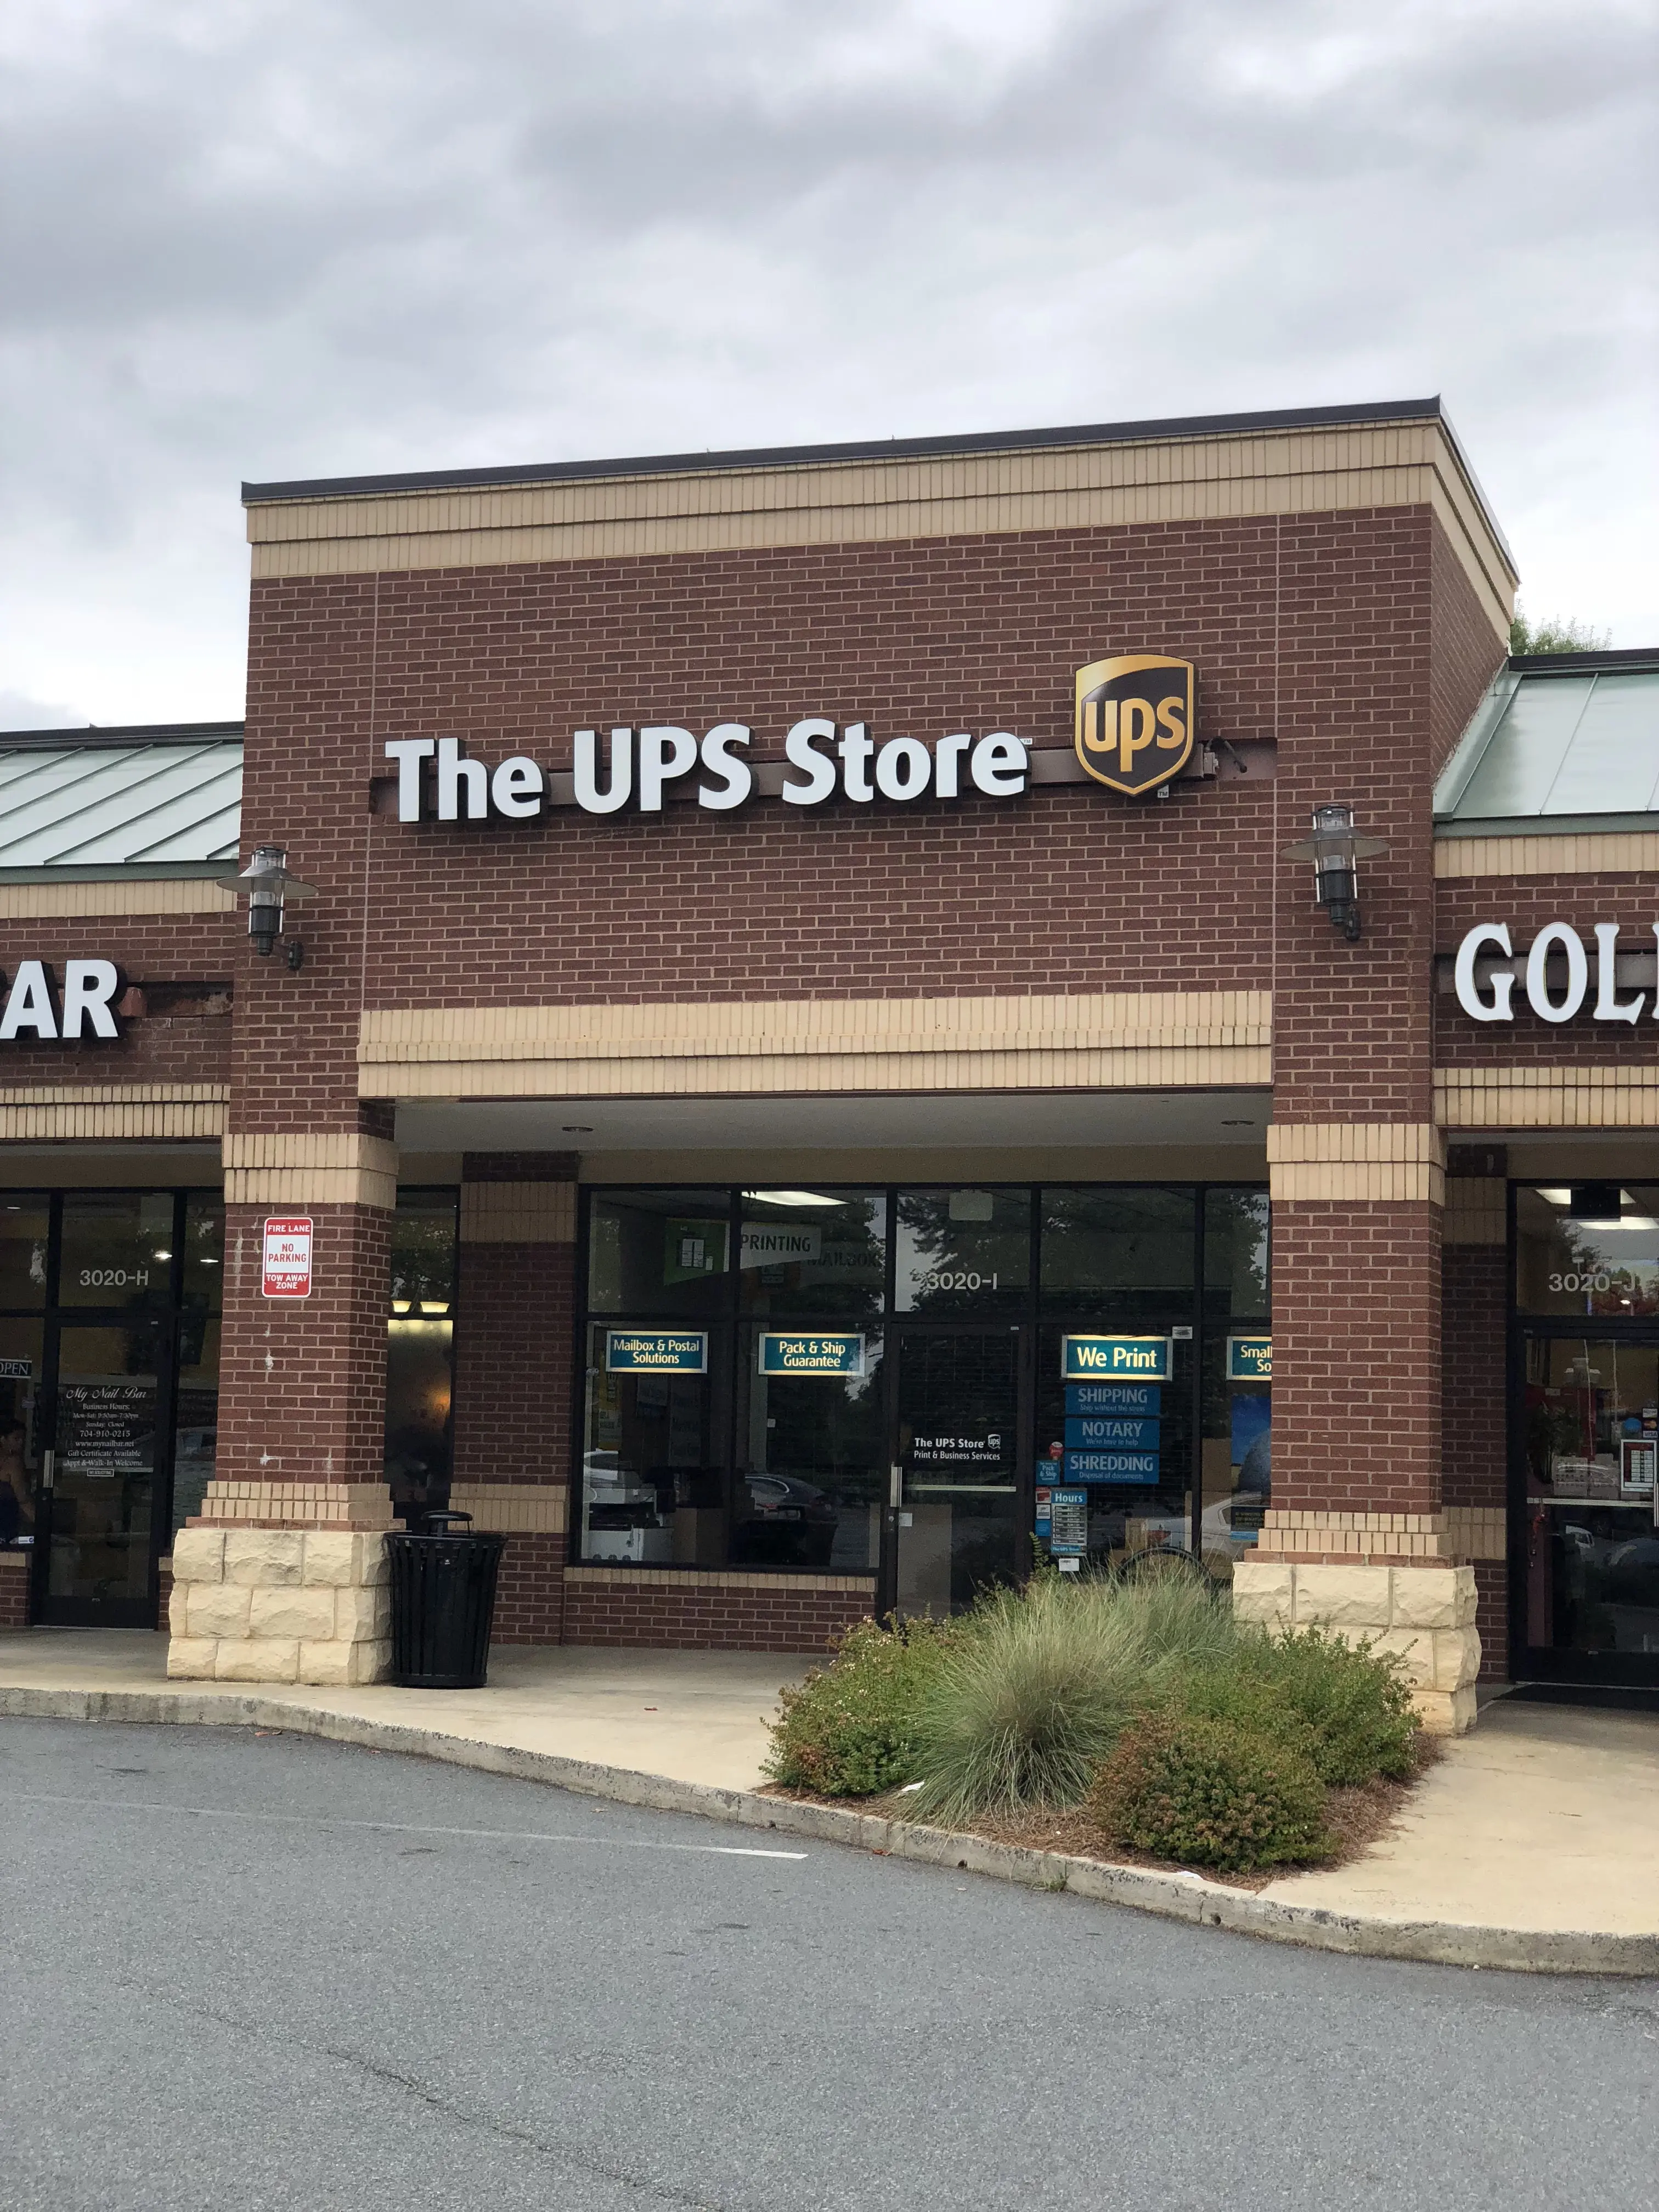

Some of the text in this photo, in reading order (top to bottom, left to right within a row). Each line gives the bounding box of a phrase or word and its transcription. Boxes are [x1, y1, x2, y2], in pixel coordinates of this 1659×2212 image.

[385, 737, 544, 822] The
[574, 723, 752, 814] UPS
[782, 718, 1028, 805] Store
[1455, 922, 1659, 1025] GOL
[281, 1243, 294, 1252] NO
[741, 1234, 811, 1252] PRINTING
[268, 1254, 307, 1262] PARKING
[80, 1269, 149, 1286] 3020-H
[927, 1272, 997, 1290] 3020-I
[1549, 1272, 1635, 1292] 3020-J
[613, 1339, 699, 1351] Mailbox & Postal
[779, 1341, 846, 1357] Pack & Ship
[1240, 1345, 1272, 1358] Small
[633, 1351, 680, 1364] Solutions
[783, 1354, 841, 1367] Guarantee
[1077, 1347, 1157, 1368] We Print
[66, 1386, 146, 1402] My Nail Bar
[1078, 1388, 1148, 1404] SHIPPING
[1082, 1421, 1143, 1437] NOTARY
[915, 1437, 933, 1447] The
[935, 1438, 955, 1448] UPS
[958, 1438, 984, 1448] Store
[914, 1450, 1000, 1460] Print & Business Services
[1070, 1455, 1153, 1472] SHREDDING
[1079, 1471, 1104, 1480] Disposal
[1055, 1492, 1083, 1503] Hours
